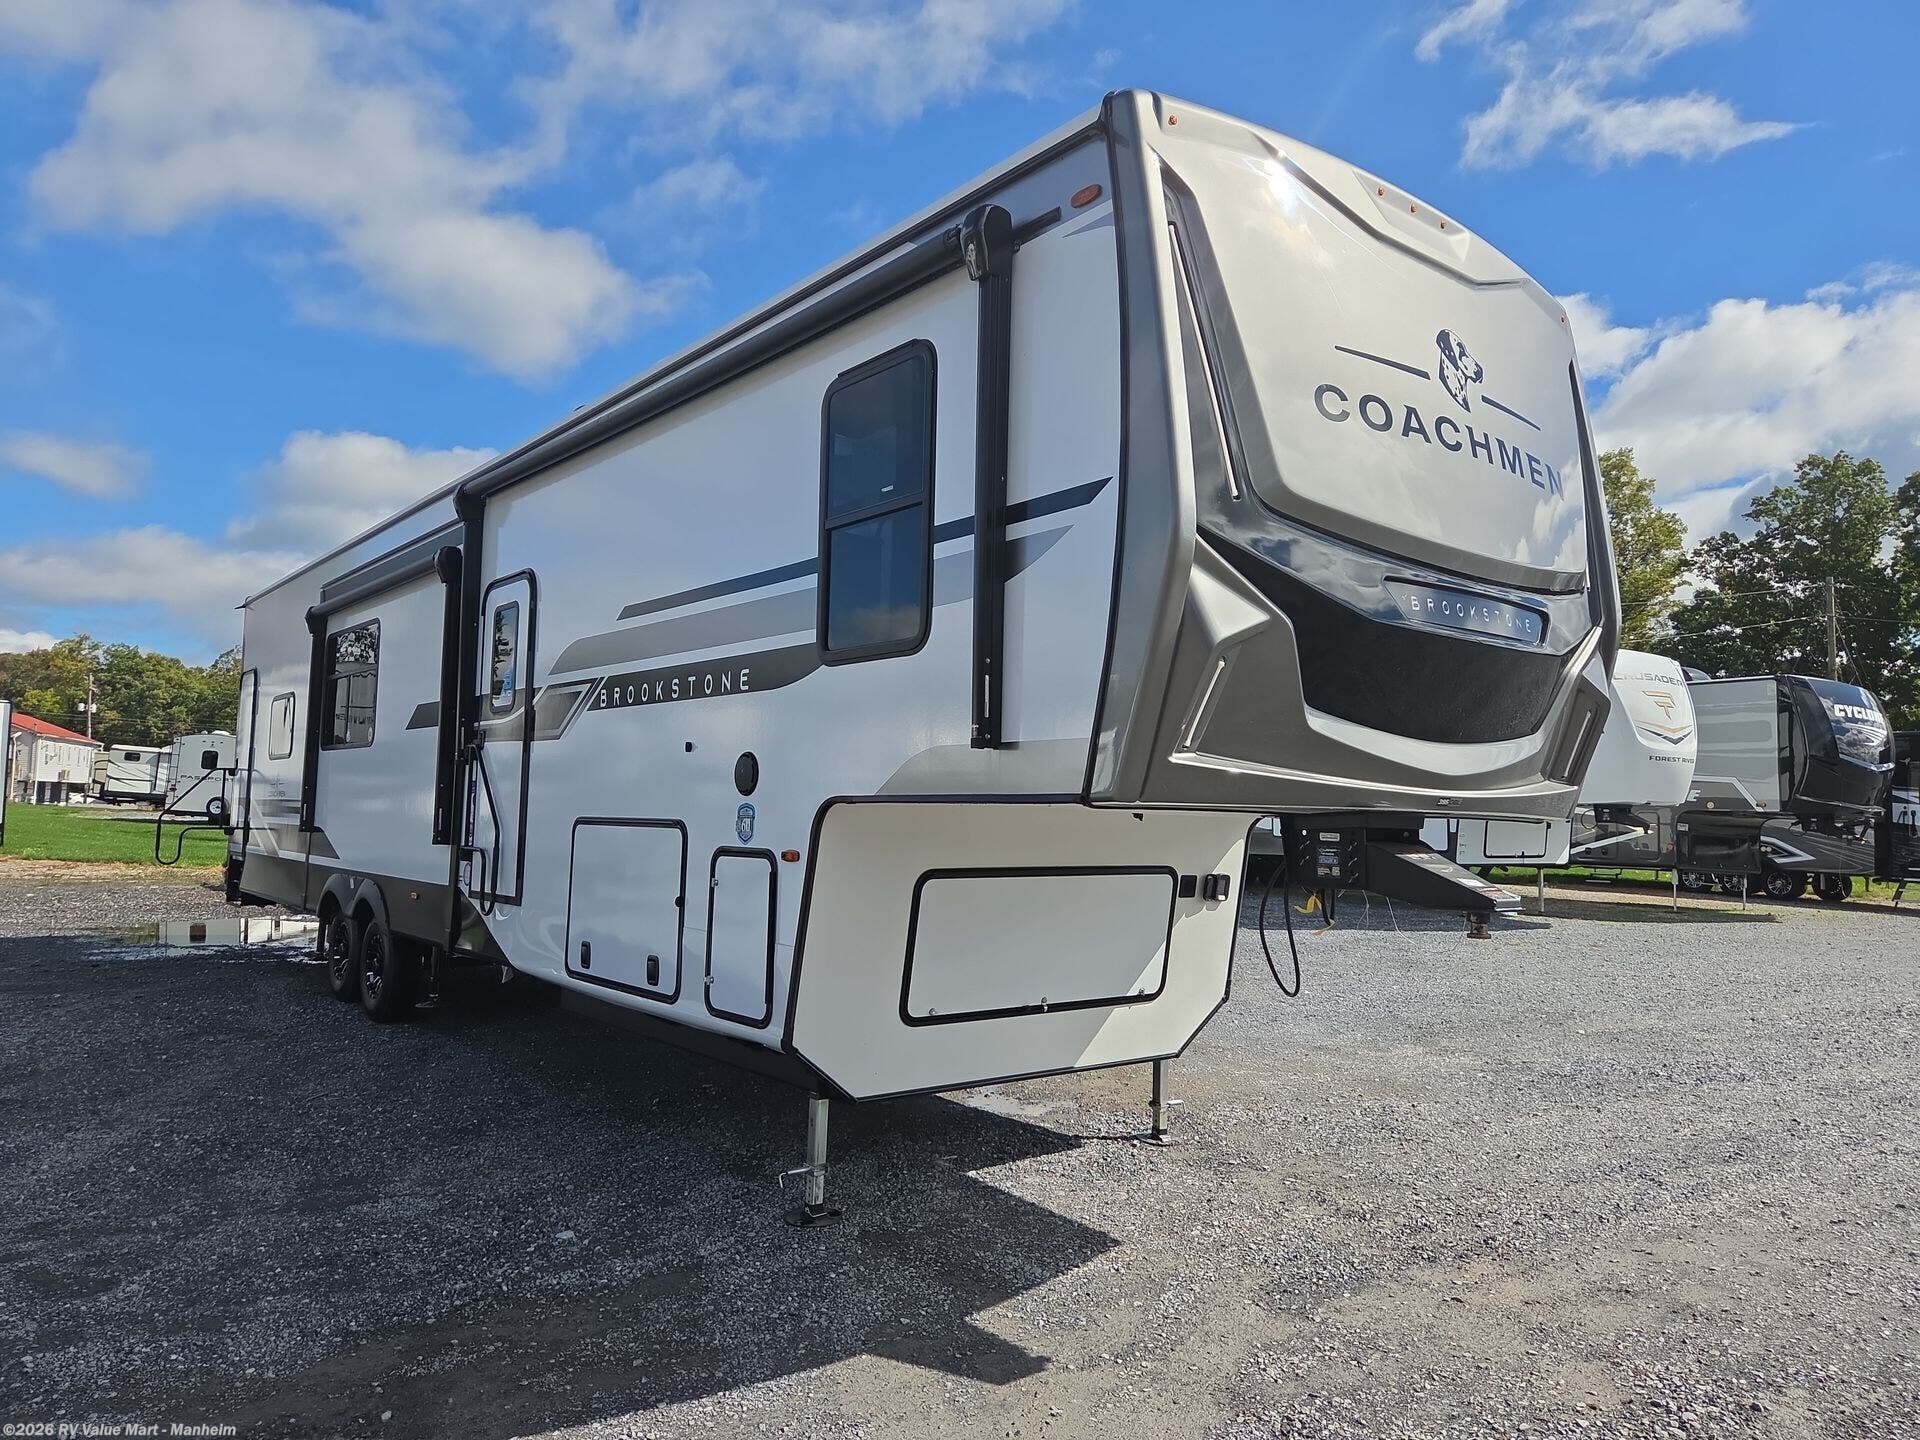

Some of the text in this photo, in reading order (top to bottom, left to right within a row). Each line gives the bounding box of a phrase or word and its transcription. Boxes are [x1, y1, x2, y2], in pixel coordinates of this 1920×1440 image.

[1313, 382, 1565, 500] COACHMEN
[1409, 595, 1532, 633] BROOKSTONE
[600, 668, 750, 708] BROOKSTONE
[1613, 672, 1683, 687] CRUSADER
[1649, 755, 1681, 763] FOREST
[180, 774, 234, 782] PASPOT
